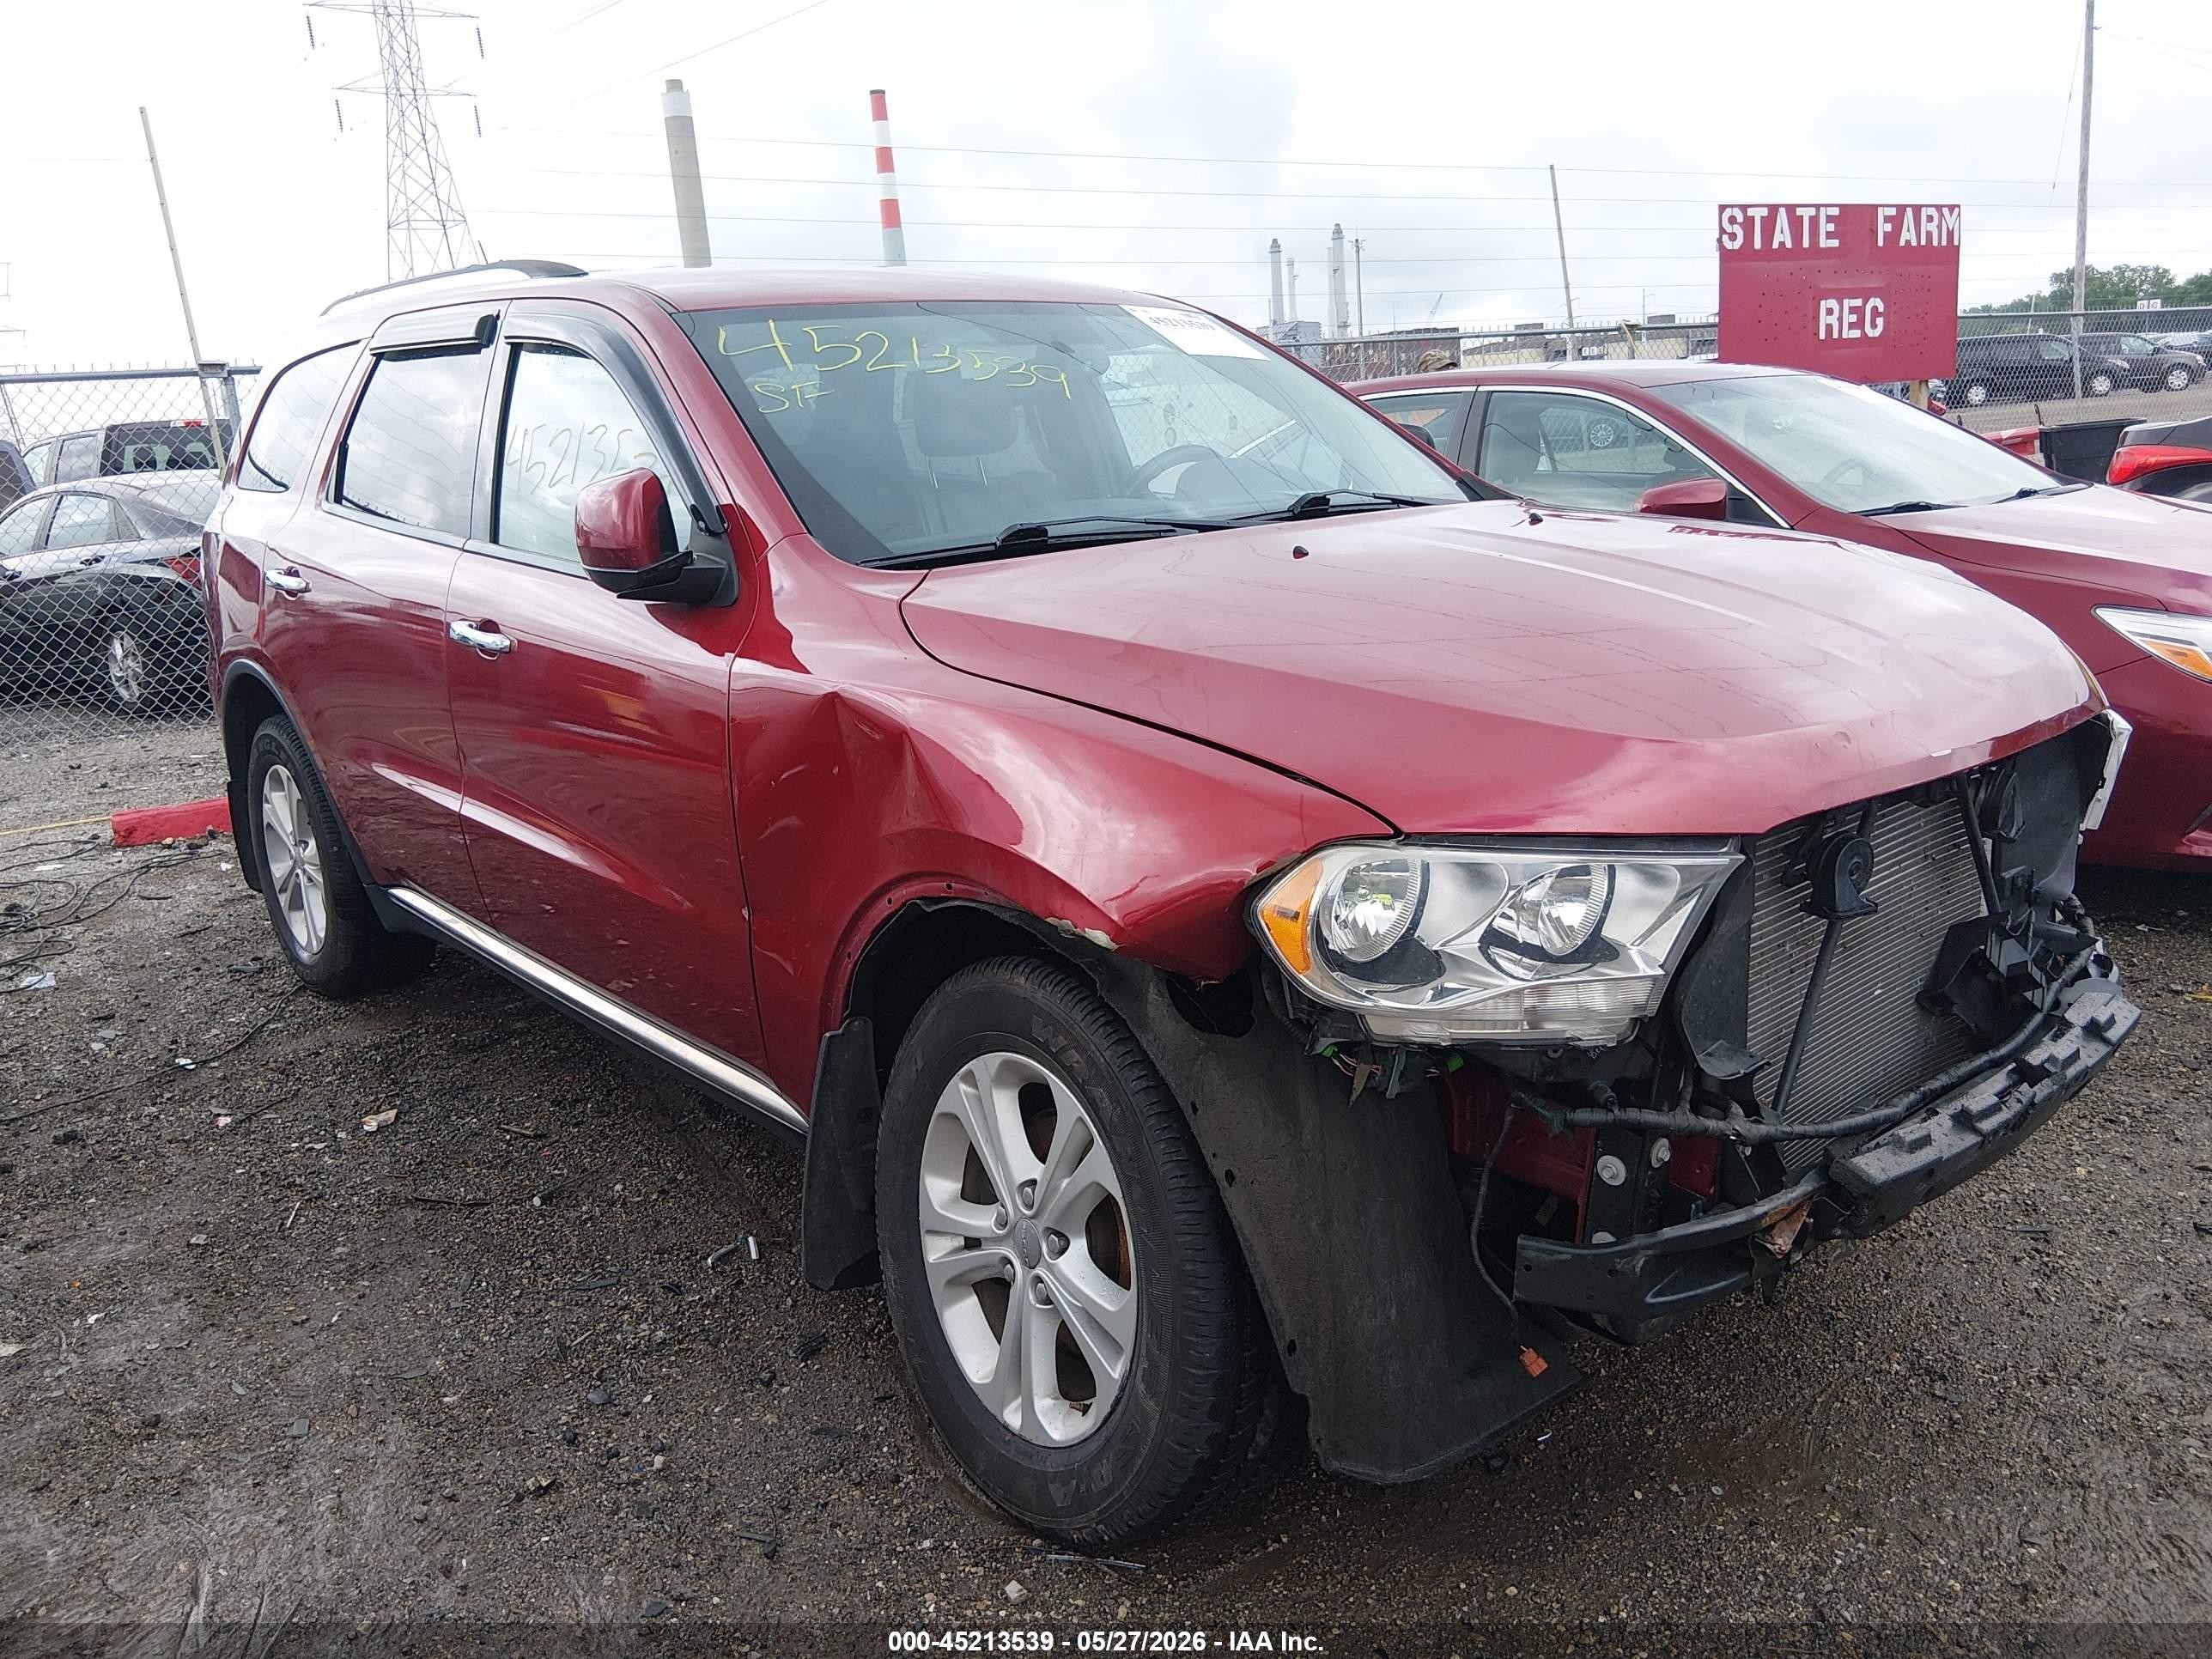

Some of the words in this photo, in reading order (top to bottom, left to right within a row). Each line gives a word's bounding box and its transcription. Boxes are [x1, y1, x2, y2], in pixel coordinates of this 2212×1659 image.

[1721, 206, 1840, 250] STATE
[1877, 206, 1960, 247] FARM
[1819, 297, 1885, 340] REG
[718, 319, 1072, 400] 45213539
[754, 380, 835, 413] SF
